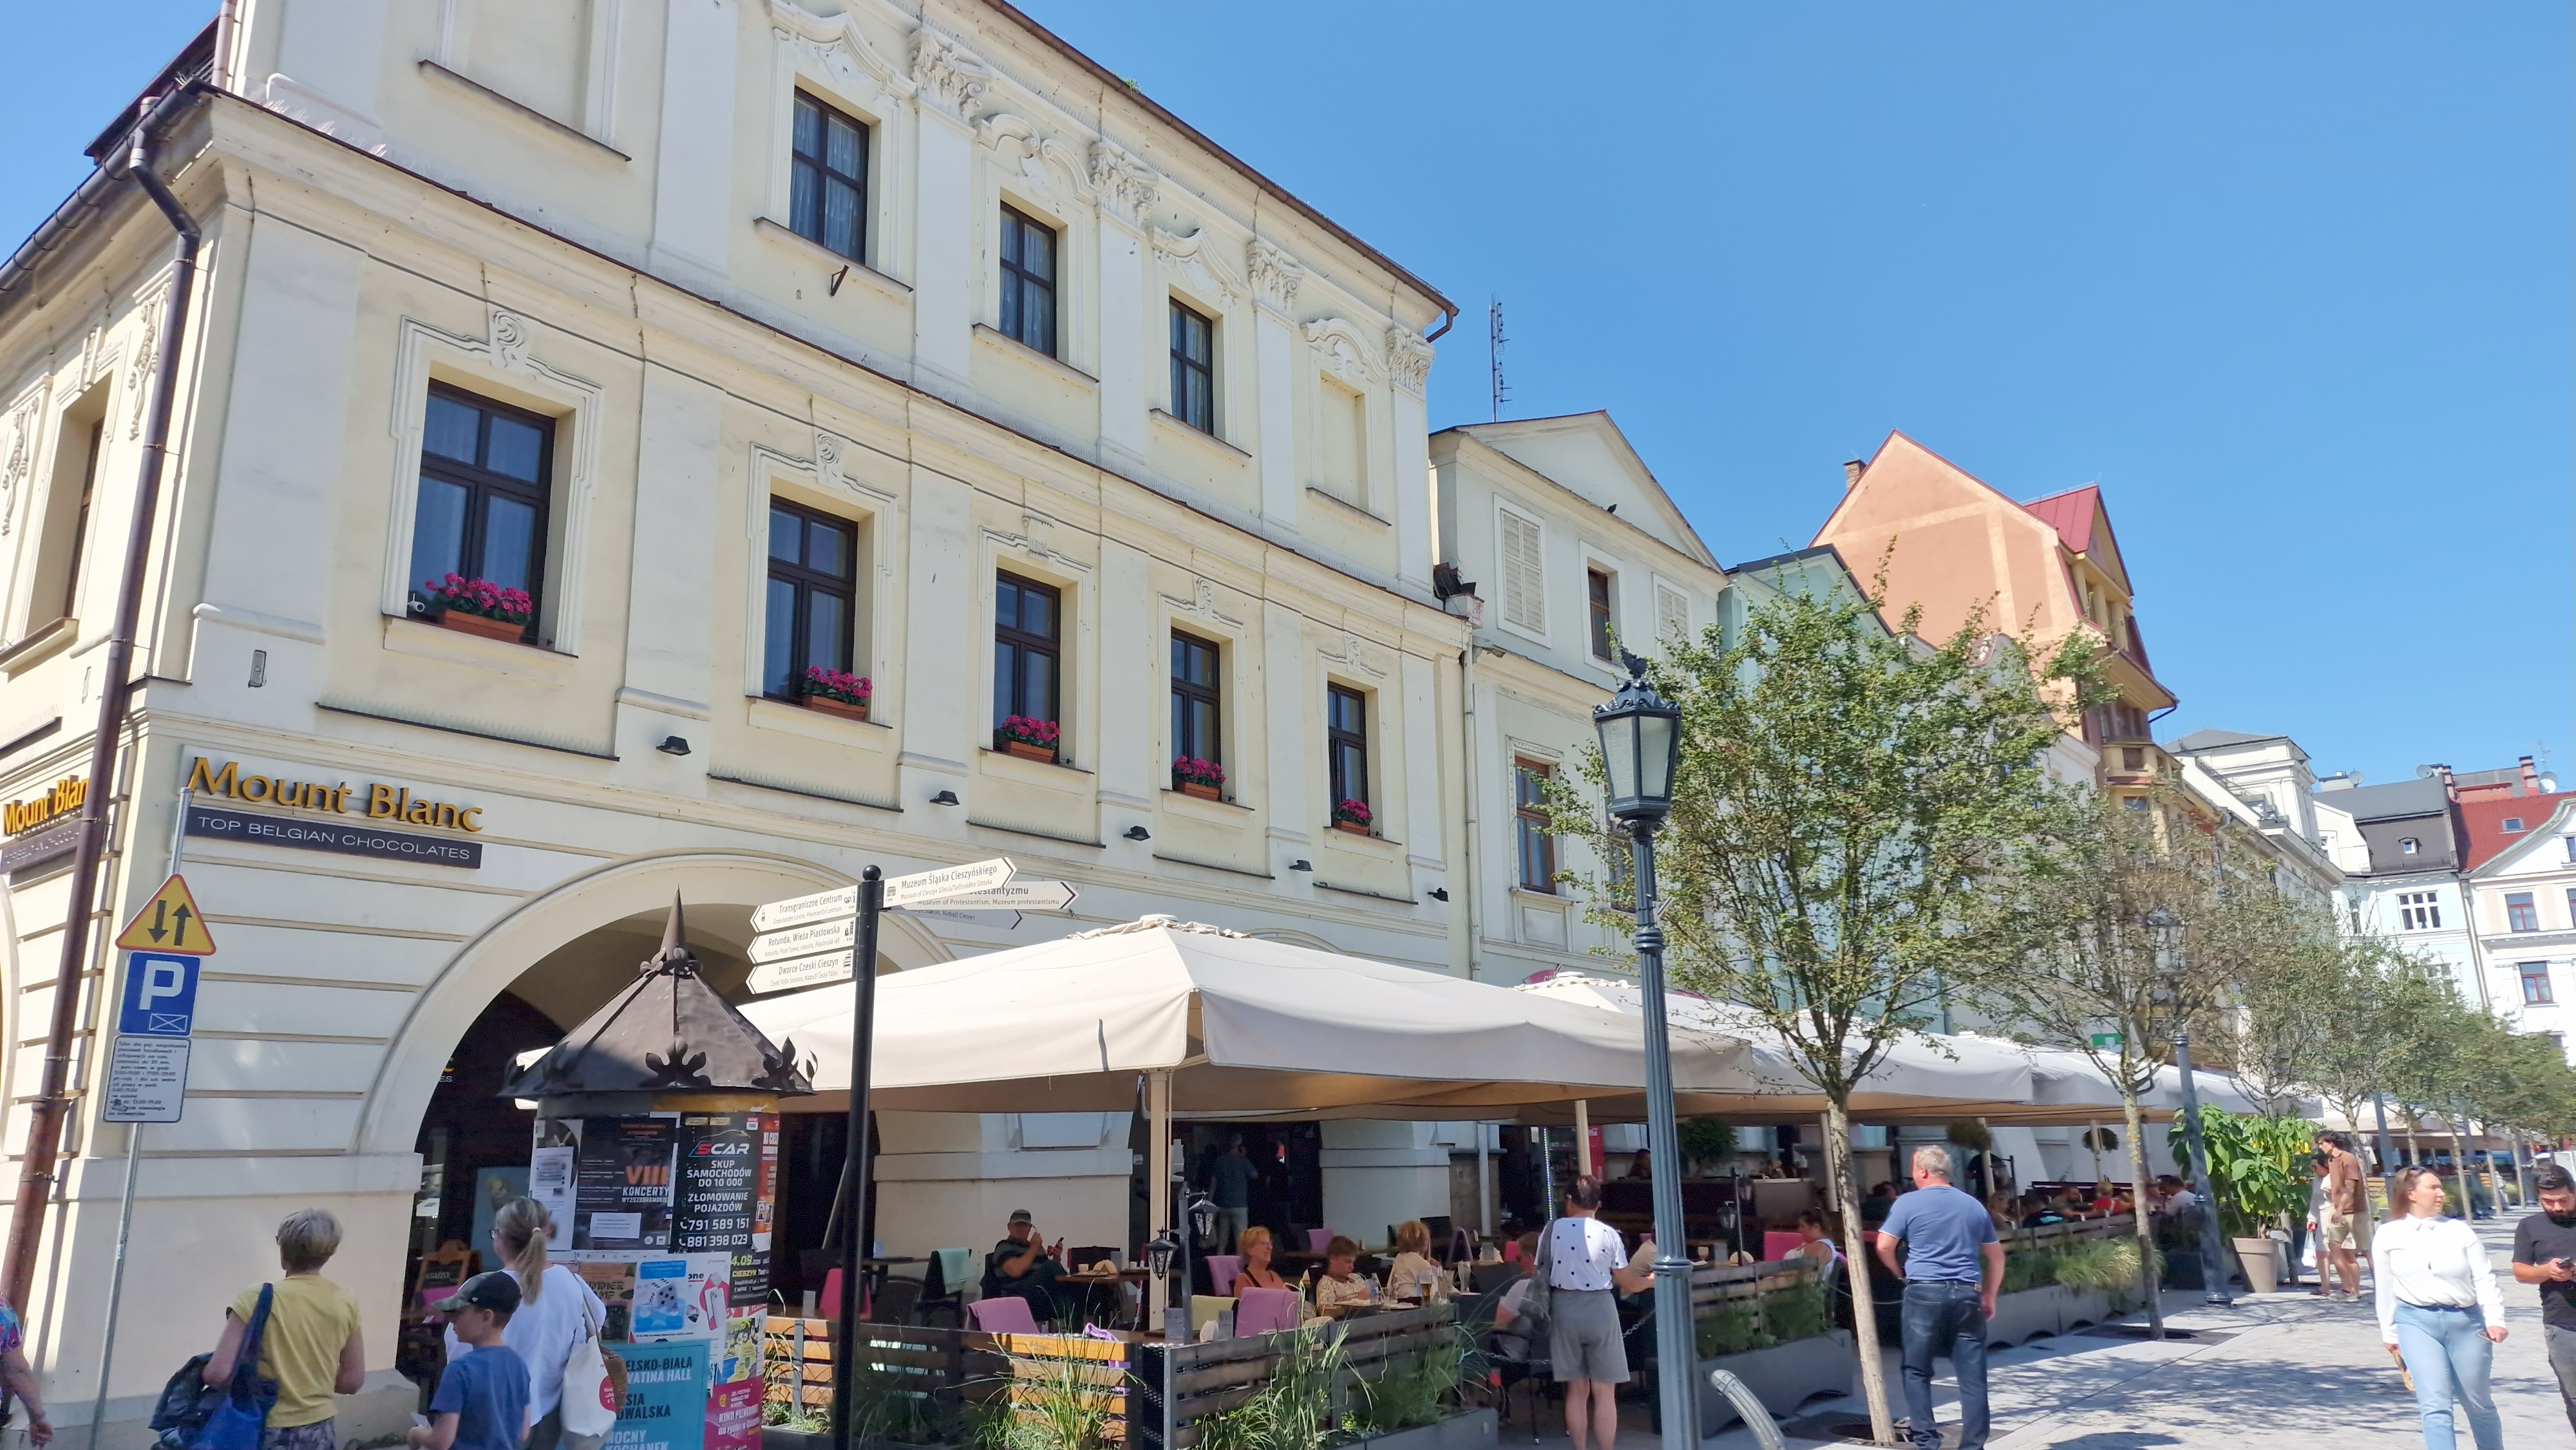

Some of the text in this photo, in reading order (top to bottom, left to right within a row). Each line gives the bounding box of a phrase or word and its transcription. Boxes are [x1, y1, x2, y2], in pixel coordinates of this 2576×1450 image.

[189, 756, 484, 833] Mount Blanc
[3, 776, 90, 835] Mount Blan
[197, 816, 469, 860] TOP BELGIAN CHOCOLATES
[902, 865, 998, 889] Muzeum Śląska Cieszyńskiego
[967, 887, 1028, 896] testantyzmu
[779, 899, 819, 914] Transgraniczne
[819, 894, 842, 905] Centrum
[768, 925, 840, 947] Rotunda, Wieża Piastowska
[799, 961, 817, 971] Czeski
[818, 958, 838, 968] Cieszyn
[138, 959, 185, 1010] P
[696, 1142, 750, 1155] SCAR
[710, 1160, 735, 1169] SKUP
[625, 1165, 668, 1185] VIII
[687, 1167, 752, 1178] SAMOCHODÓW
[698, 1178, 743, 1187] DO 10 000
[622, 1186, 670, 1196] KONCERTY
[687, 1192, 748, 1202] ZŁOMOWANIE
[694, 1201, 743, 1213] POJAZDÓW
[688, 1218, 750, 1231] 791 589 151
[687, 1234, 748, 1247] 881 398 023
[626, 1357, 692, 1372] ELSKO-BIAŁA
[627, 1369, 692, 1384] VATINA HALL
[626, 1393, 645, 1407] SIA
[616, 1404, 671, 1420] OWALSKA
